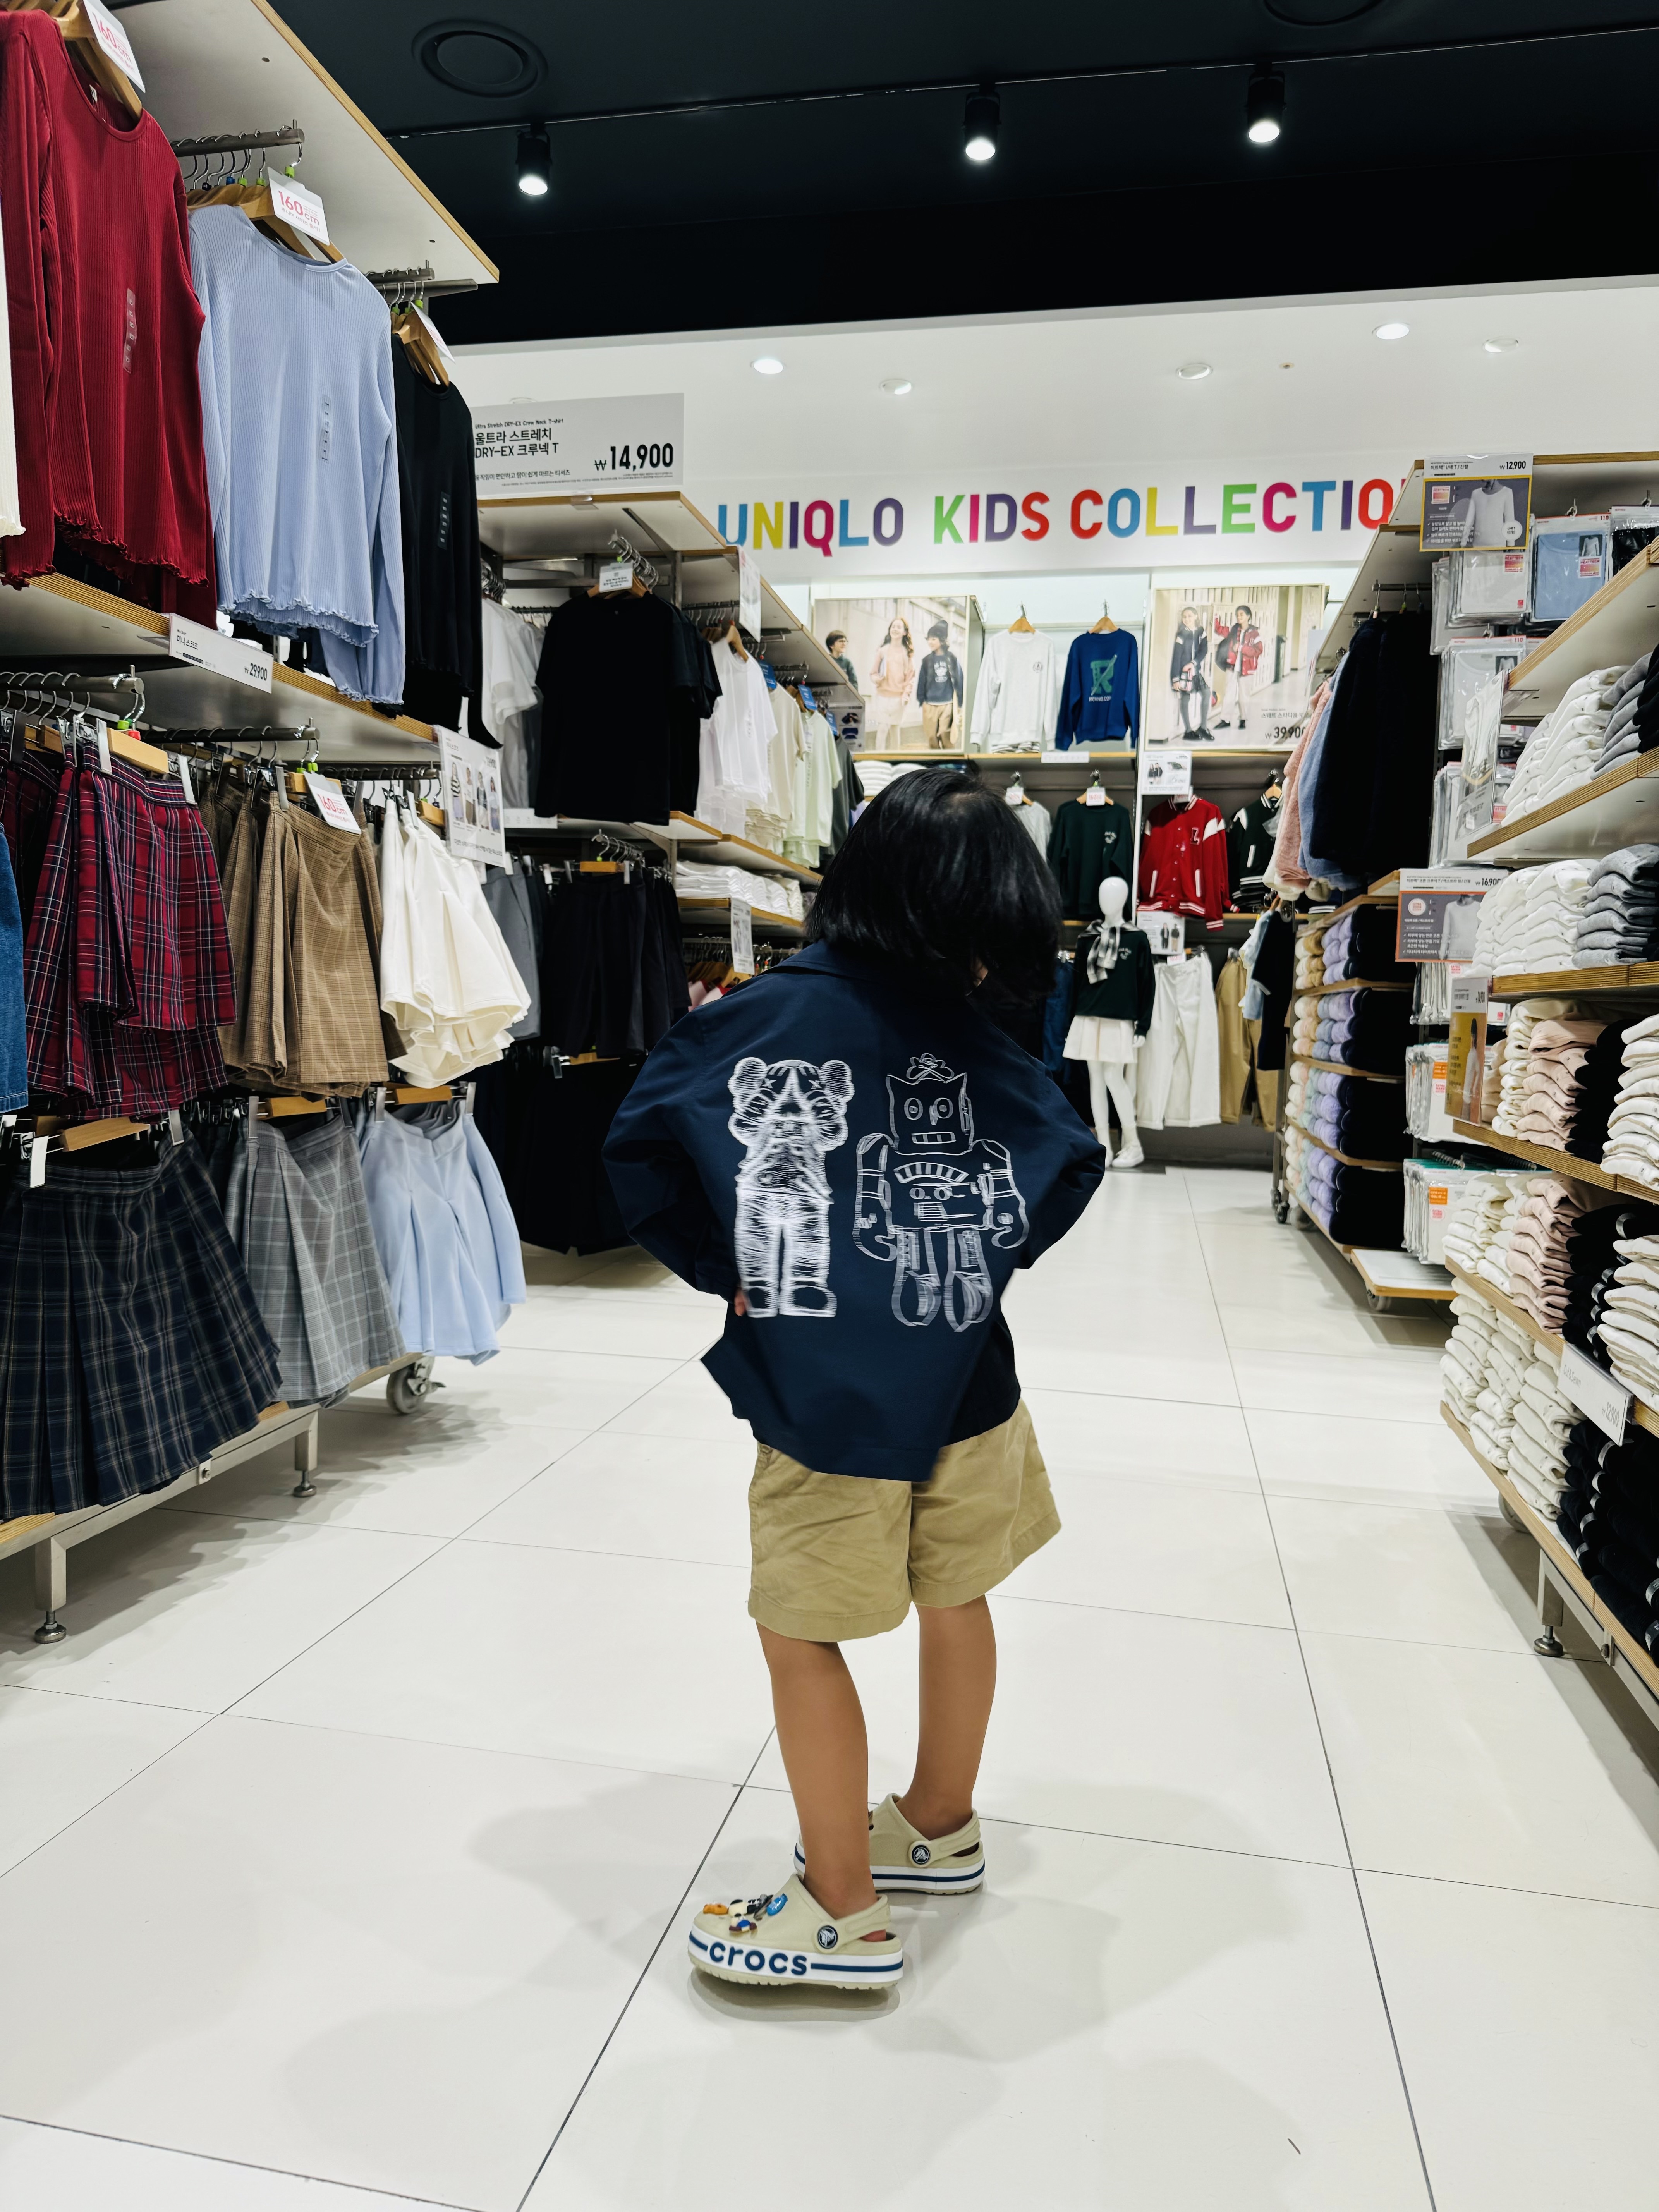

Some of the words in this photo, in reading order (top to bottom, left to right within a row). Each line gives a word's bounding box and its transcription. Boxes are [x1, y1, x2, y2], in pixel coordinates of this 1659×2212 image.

[475, 431, 507, 445] 울트라
[509, 428, 551, 441] 스트레치
[475, 445, 514, 458] DRY-EX
[517, 442, 549, 456] 크루넥
[552, 443, 559, 453] T
[718, 498, 903, 557] UNIQLO
[934, 491, 1051, 544] KIDS
[1070, 478, 1405, 540] COLLECTIO
[709, 1942, 807, 1975] crocs
